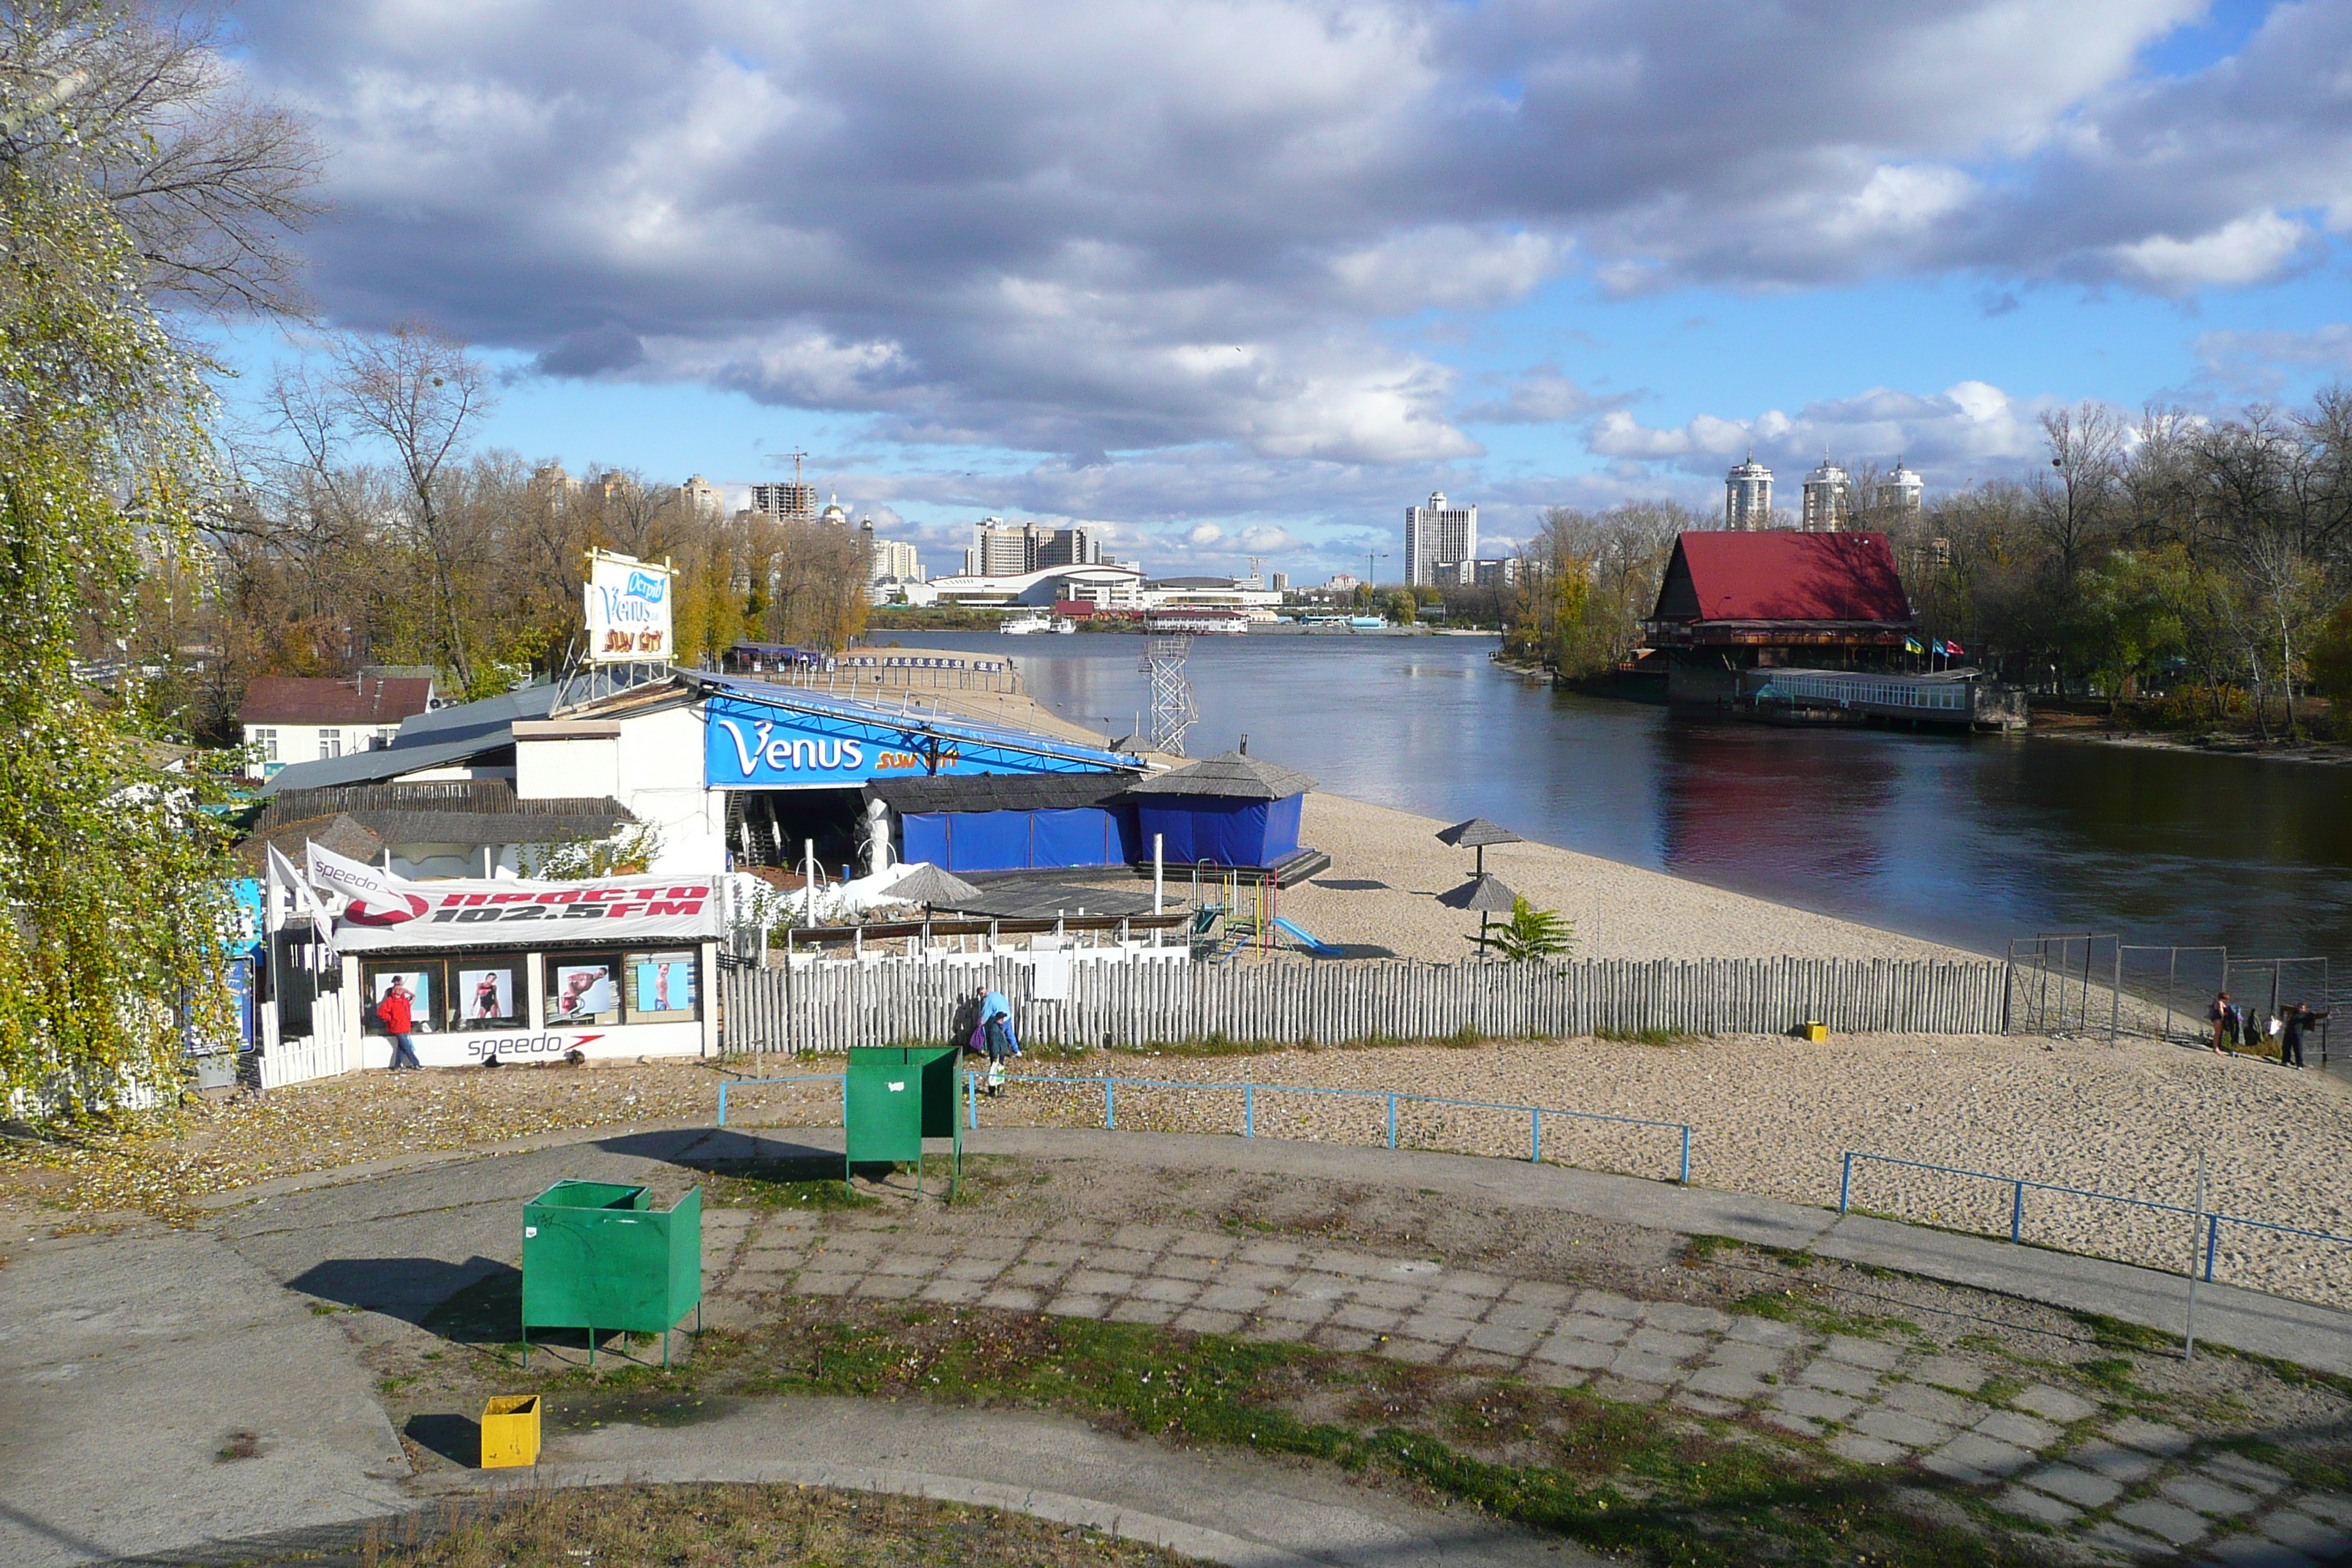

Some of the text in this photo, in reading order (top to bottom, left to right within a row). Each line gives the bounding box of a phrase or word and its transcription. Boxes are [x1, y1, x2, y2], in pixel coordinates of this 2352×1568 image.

[599, 585, 650, 625] Venus
[719, 720, 864, 778] Venus
[315, 862, 378, 891] speedo
[440, 886, 709, 907] ПРОСТО
[468, 1032, 562, 1060] speedo
